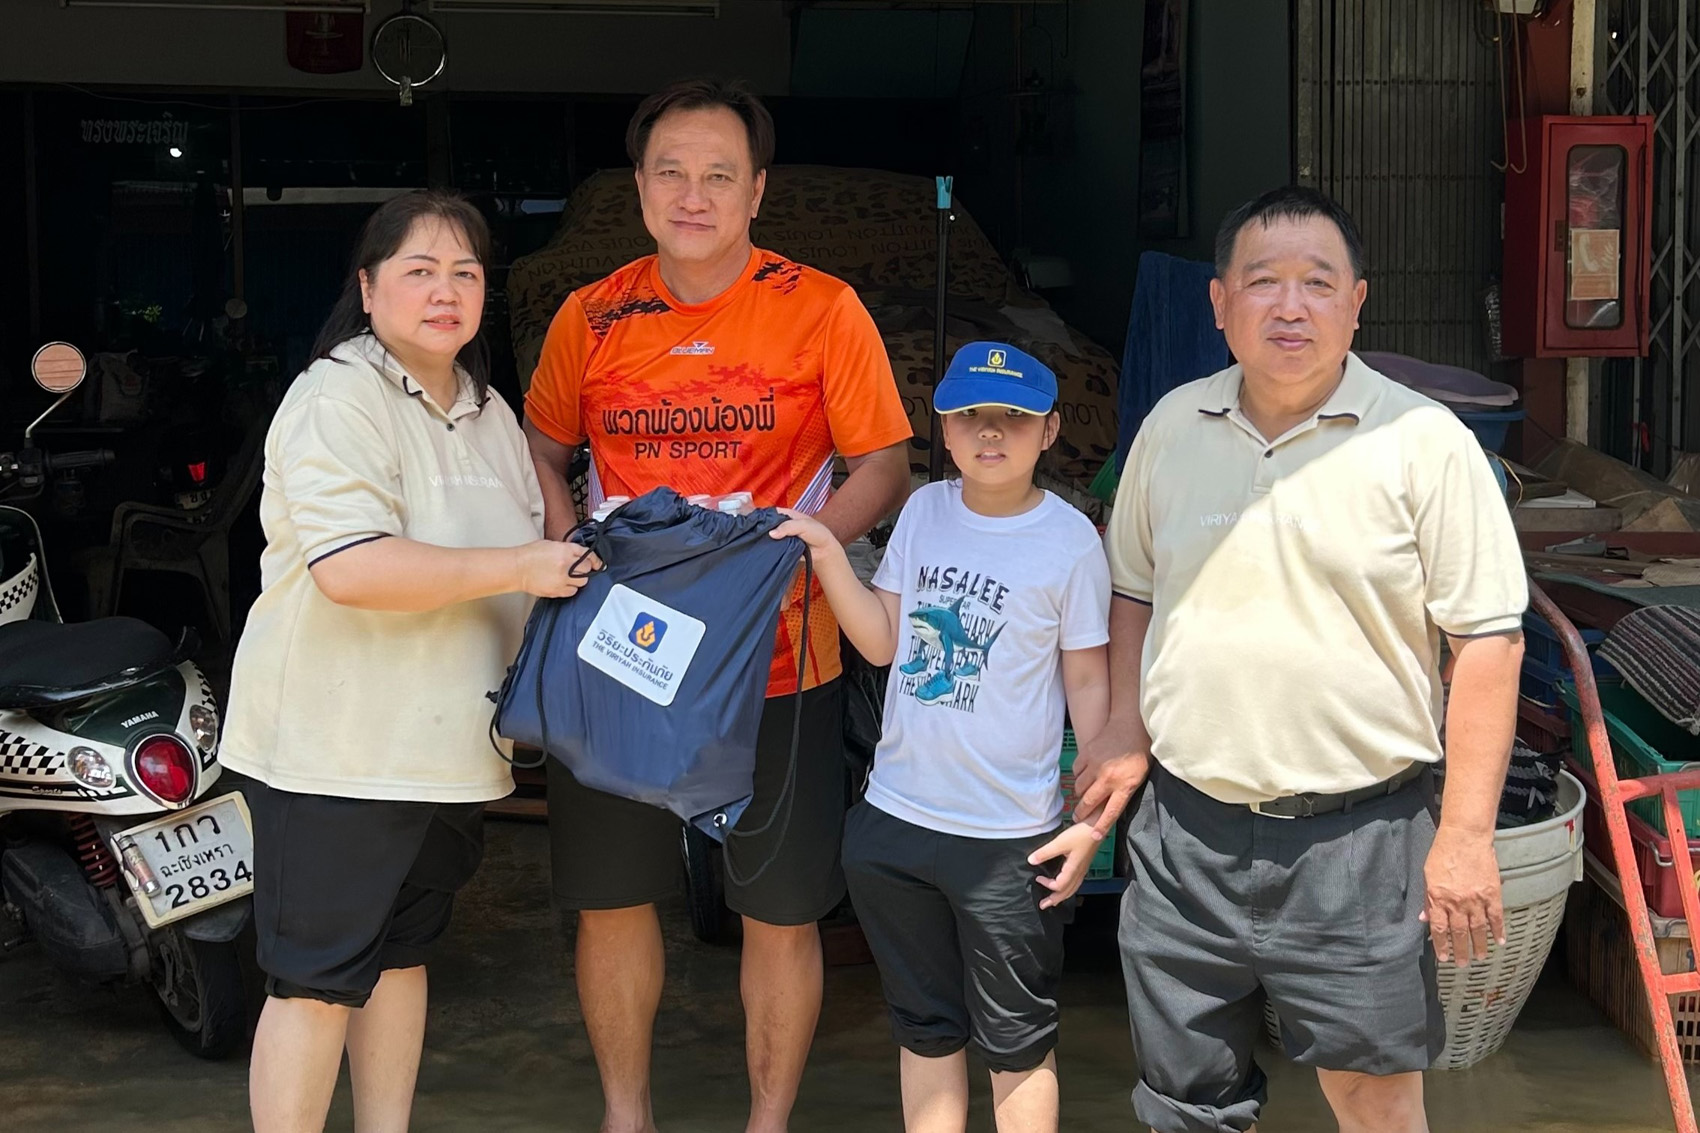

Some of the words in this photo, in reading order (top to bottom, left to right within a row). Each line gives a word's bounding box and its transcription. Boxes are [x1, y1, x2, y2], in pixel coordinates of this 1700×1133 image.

[599, 237, 650, 250] OUIS
[603, 387, 775, 435] พวกพ้องน้องพี่
[635, 442, 661, 459] PN
[669, 441, 742, 459] SPORT
[916, 565, 1010, 615] NASALEE
[592, 641, 605, 653] THE
[606, 649, 632, 668] VIRIYAH
[631, 665, 669, 690] INSURANCE
[597, 629, 674, 681] วิริยะประกันภัย
[121, 711, 159, 728] YAMAHA
[155, 815, 221, 853] 1กว
[160, 843, 234, 878] ฉะเชิงเทรา
[165, 860, 252, 909] 2834
